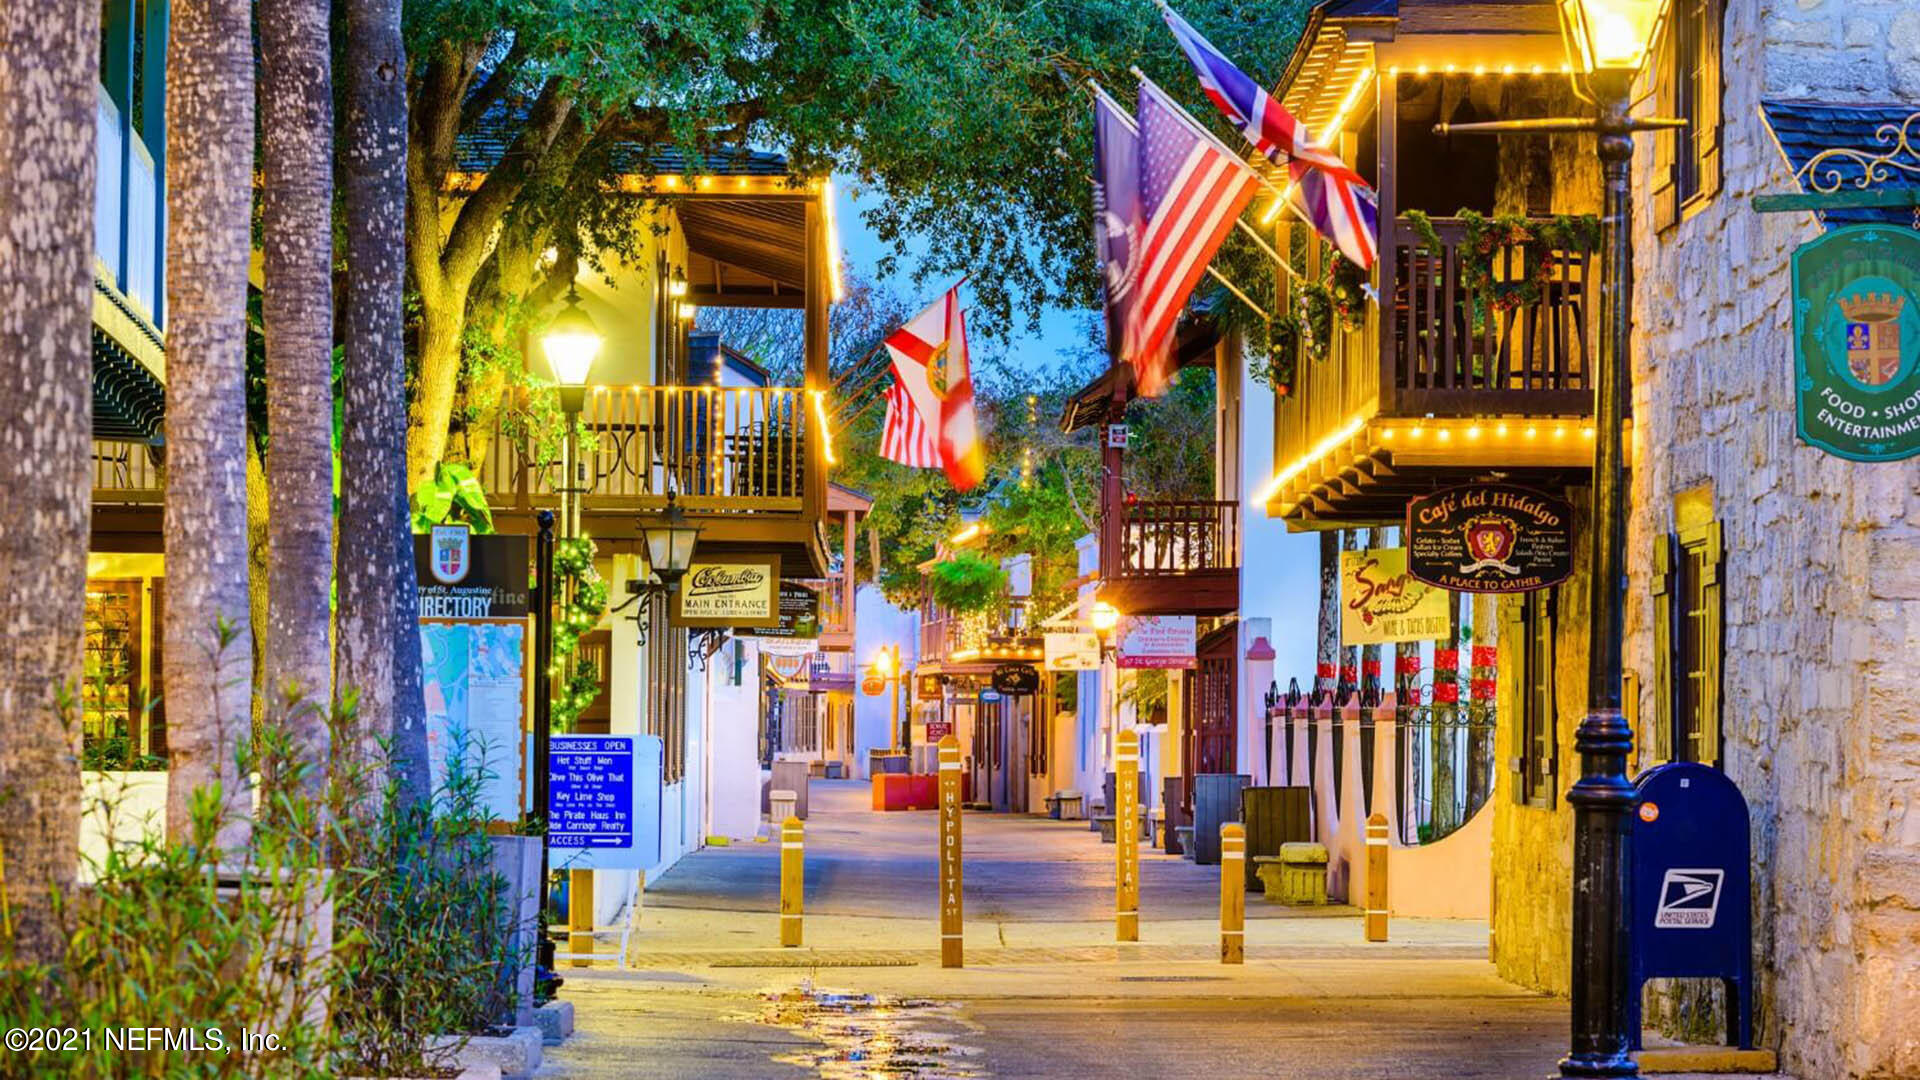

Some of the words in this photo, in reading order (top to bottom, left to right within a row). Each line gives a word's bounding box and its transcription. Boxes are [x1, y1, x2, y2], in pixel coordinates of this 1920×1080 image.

[1820, 386, 1865, 419] FOOD
[1817, 408, 1920, 439] ENTERTAINME
[1420, 492, 1457, 524] Café
[1462, 490, 1486, 508] del
[1493, 491, 1560, 527] Hidalgo
[691, 567, 764, 589] Columbia
[1439, 575, 1447, 584] A
[1450, 577, 1480, 589] PLACE
[1484, 580, 1498, 590] TO
[1501, 575, 1542, 590] GATHER
[450, 585, 492, 595] Augustine
[420, 596, 492, 617] IRECTORY
[685, 599, 710, 609] MAIN
[714, 599, 768, 609] ENTRANCE
[549, 741, 597, 751] BUSINESSES
[604, 741, 626, 751] OPEN
[557, 756, 571, 765] Hot
[574, 756, 593, 766] Stuff
[569, 772, 584, 782] This
[586, 772, 605, 782] Olive
[608, 772, 625, 782] That
[556, 791, 571, 802] Key
[574, 791, 593, 801] Lime
[596, 791, 616, 802] Shop
[564, 810, 586, 820] Pirate
[614, 810, 627, 820] Inn
[566, 821, 597, 832] Carriage
[602, 821, 625, 832] Realty
[1123, 779, 1133, 883] HYPOLITA
[550, 836, 585, 846] ACCESS
[945, 791, 956, 905] HYPOLITA
